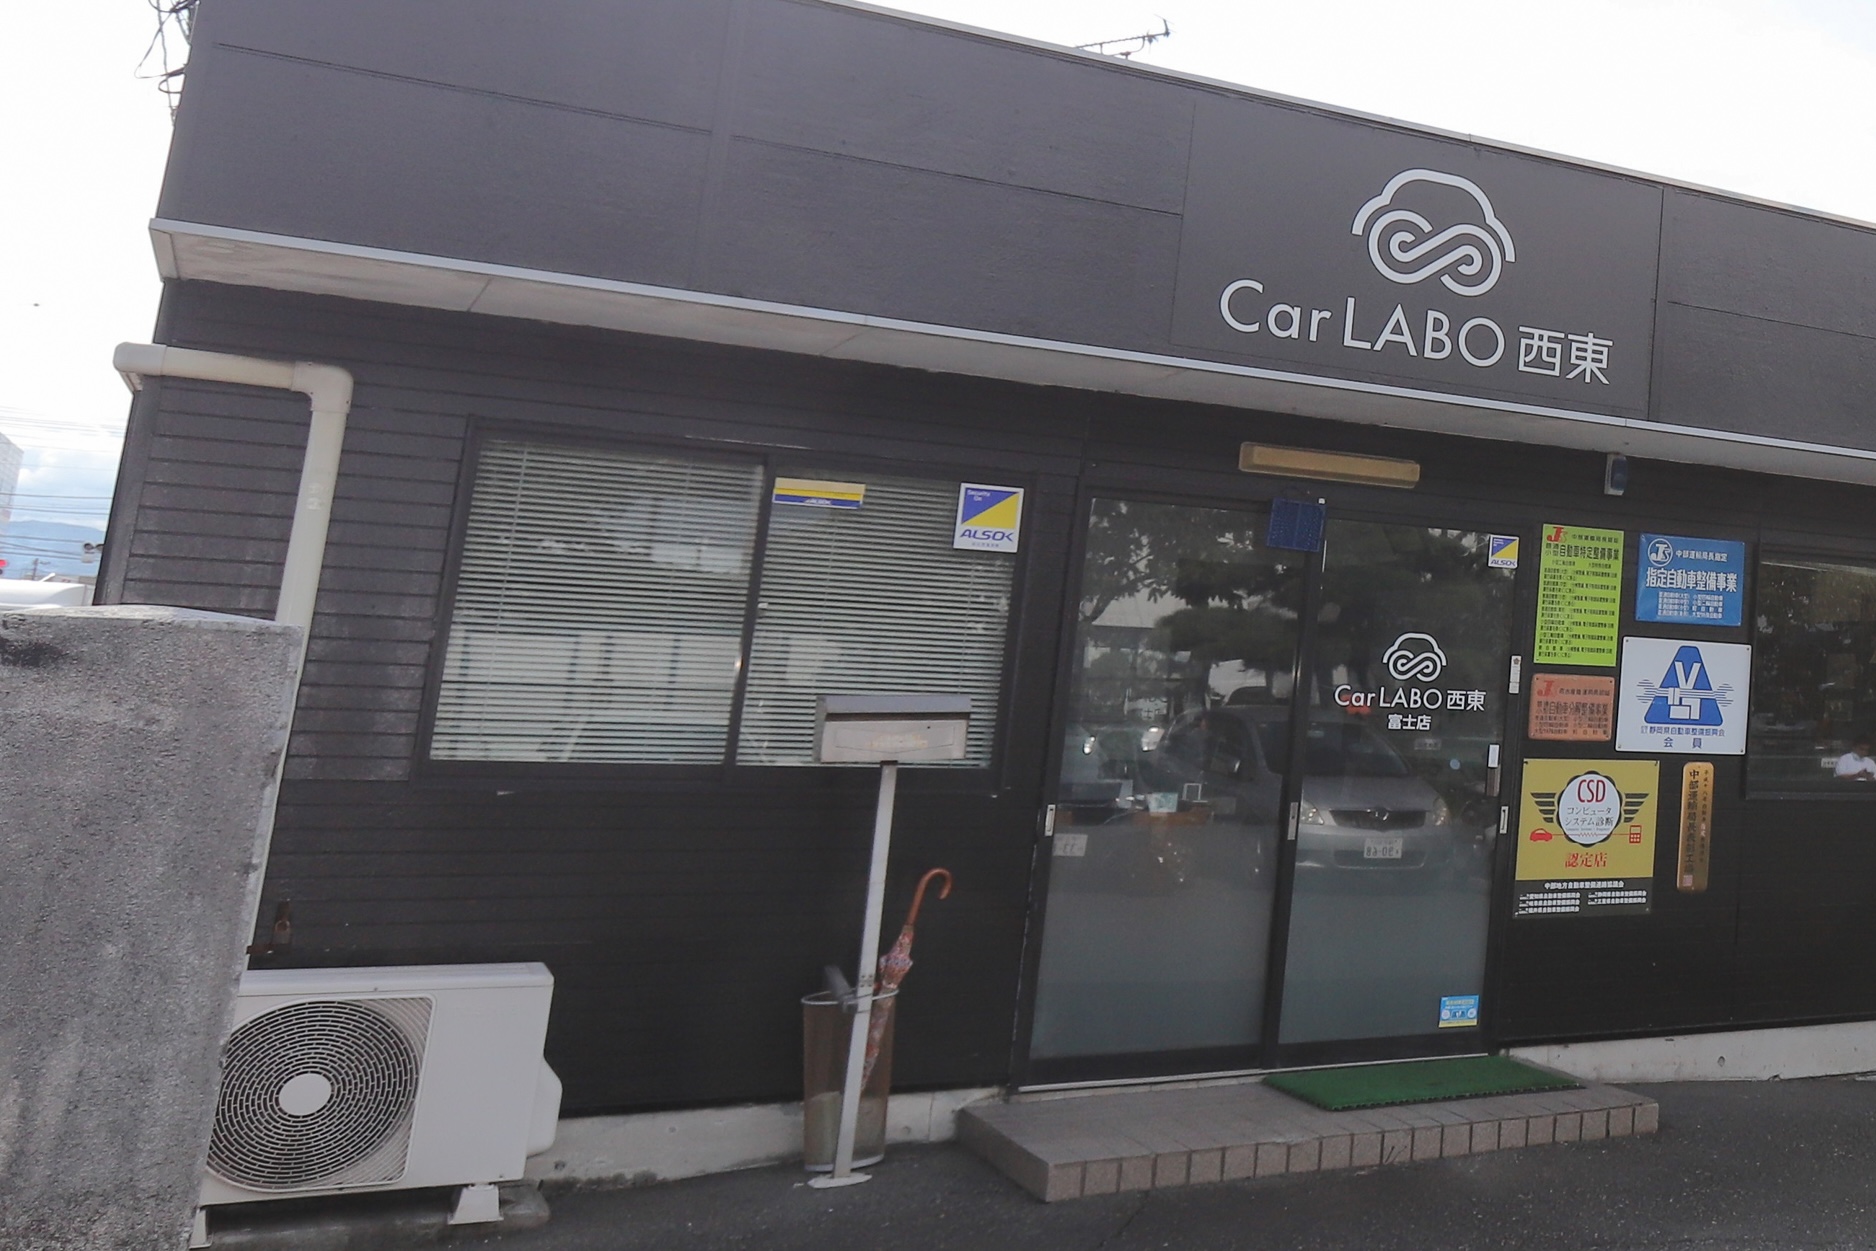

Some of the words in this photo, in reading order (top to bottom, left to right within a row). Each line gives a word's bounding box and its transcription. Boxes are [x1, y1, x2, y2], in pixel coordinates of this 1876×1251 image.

[1220, 278, 1331, 342] Car
[1343, 296, 1506, 368] LABO
[1517, 326, 1614, 386] 西東
[960, 529, 1014, 542] ALSOK
[1491, 559, 1516, 567] ALSOK
[1646, 566, 1738, 592] 指定自動車整備事業
[1334, 684, 1375, 706] Car
[1379, 686, 1442, 710] LABO
[1446, 689, 1487, 711] 西東
[1387, 714, 1432, 730] 富士店
[1577, 779, 1606, 803] CSD
[1567, 806, 1612, 816] コンピュータ
[1564, 816, 1614, 827] システム診断
[1565, 852, 1607, 868] 認定店
